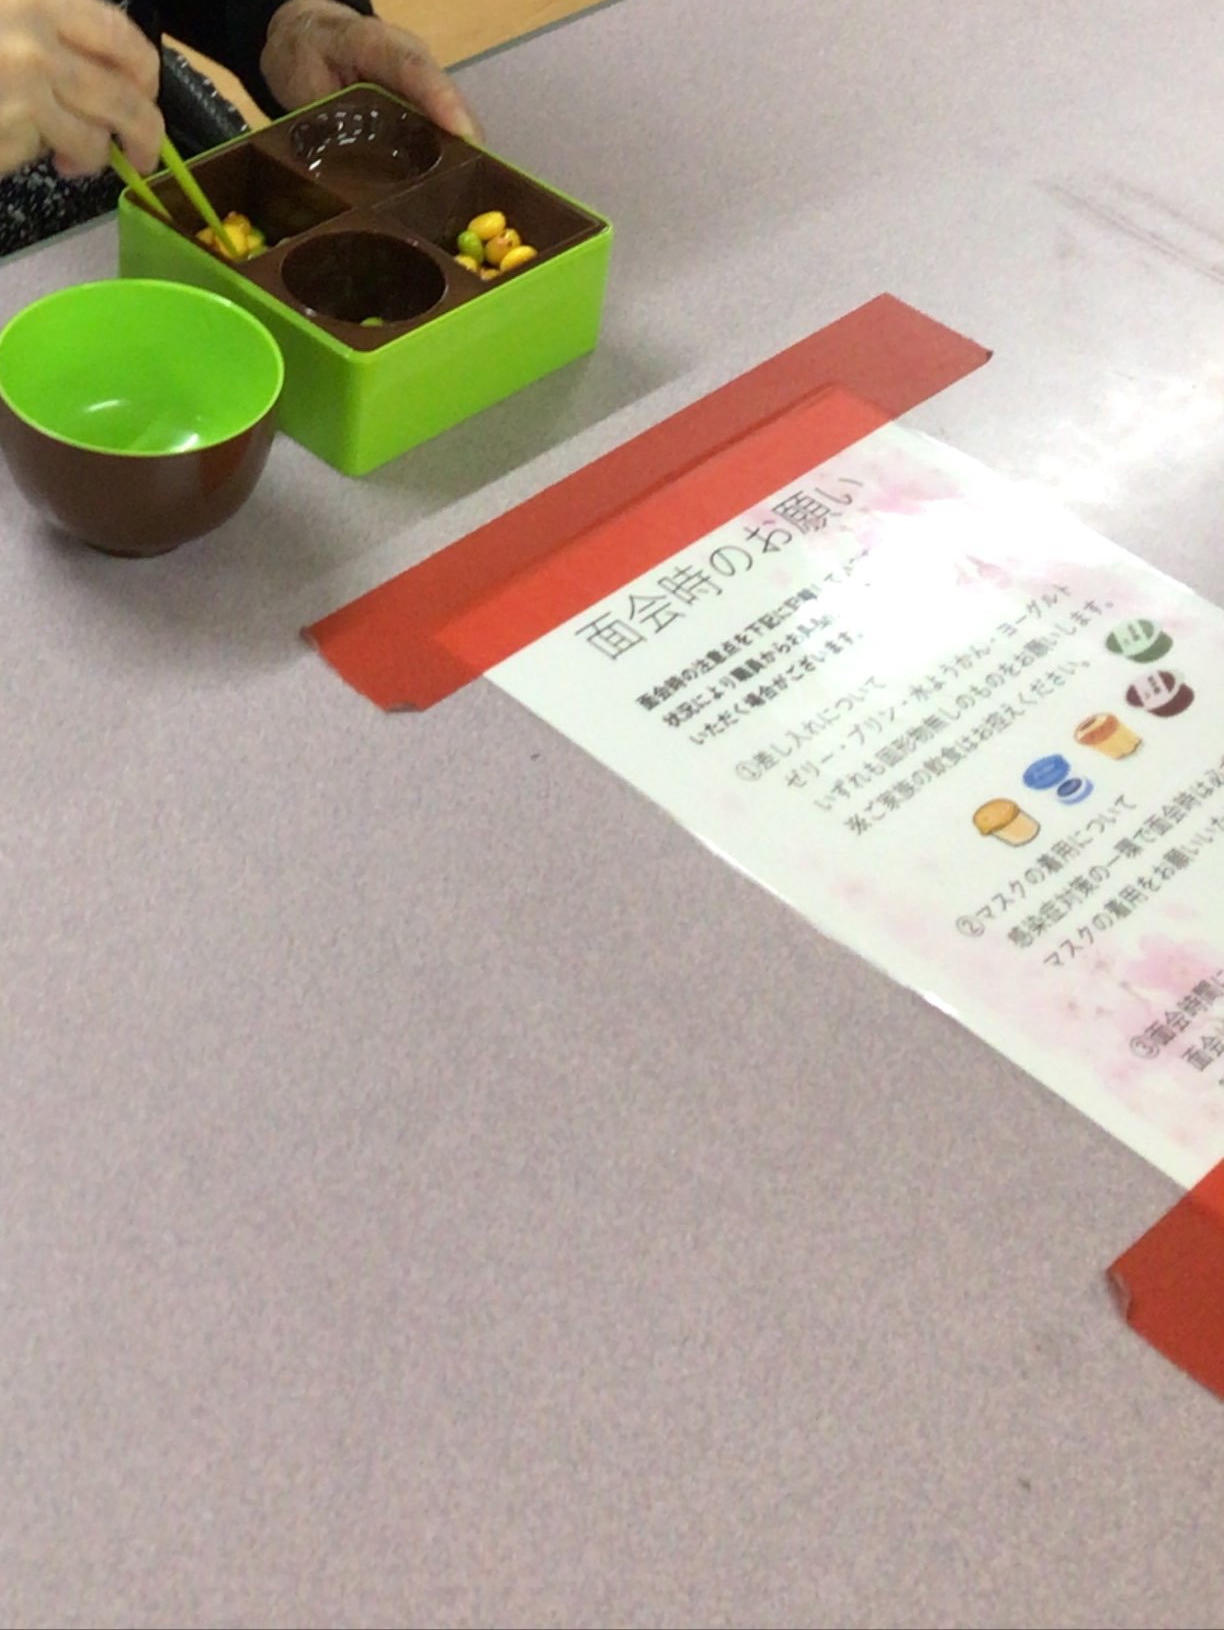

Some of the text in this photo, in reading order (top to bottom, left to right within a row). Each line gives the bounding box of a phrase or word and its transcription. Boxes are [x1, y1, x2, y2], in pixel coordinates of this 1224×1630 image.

[576, 477, 864, 660] 面会時のお願い
[1006, 754, 1224, 949] 感染症対策の一環で面会時は必
